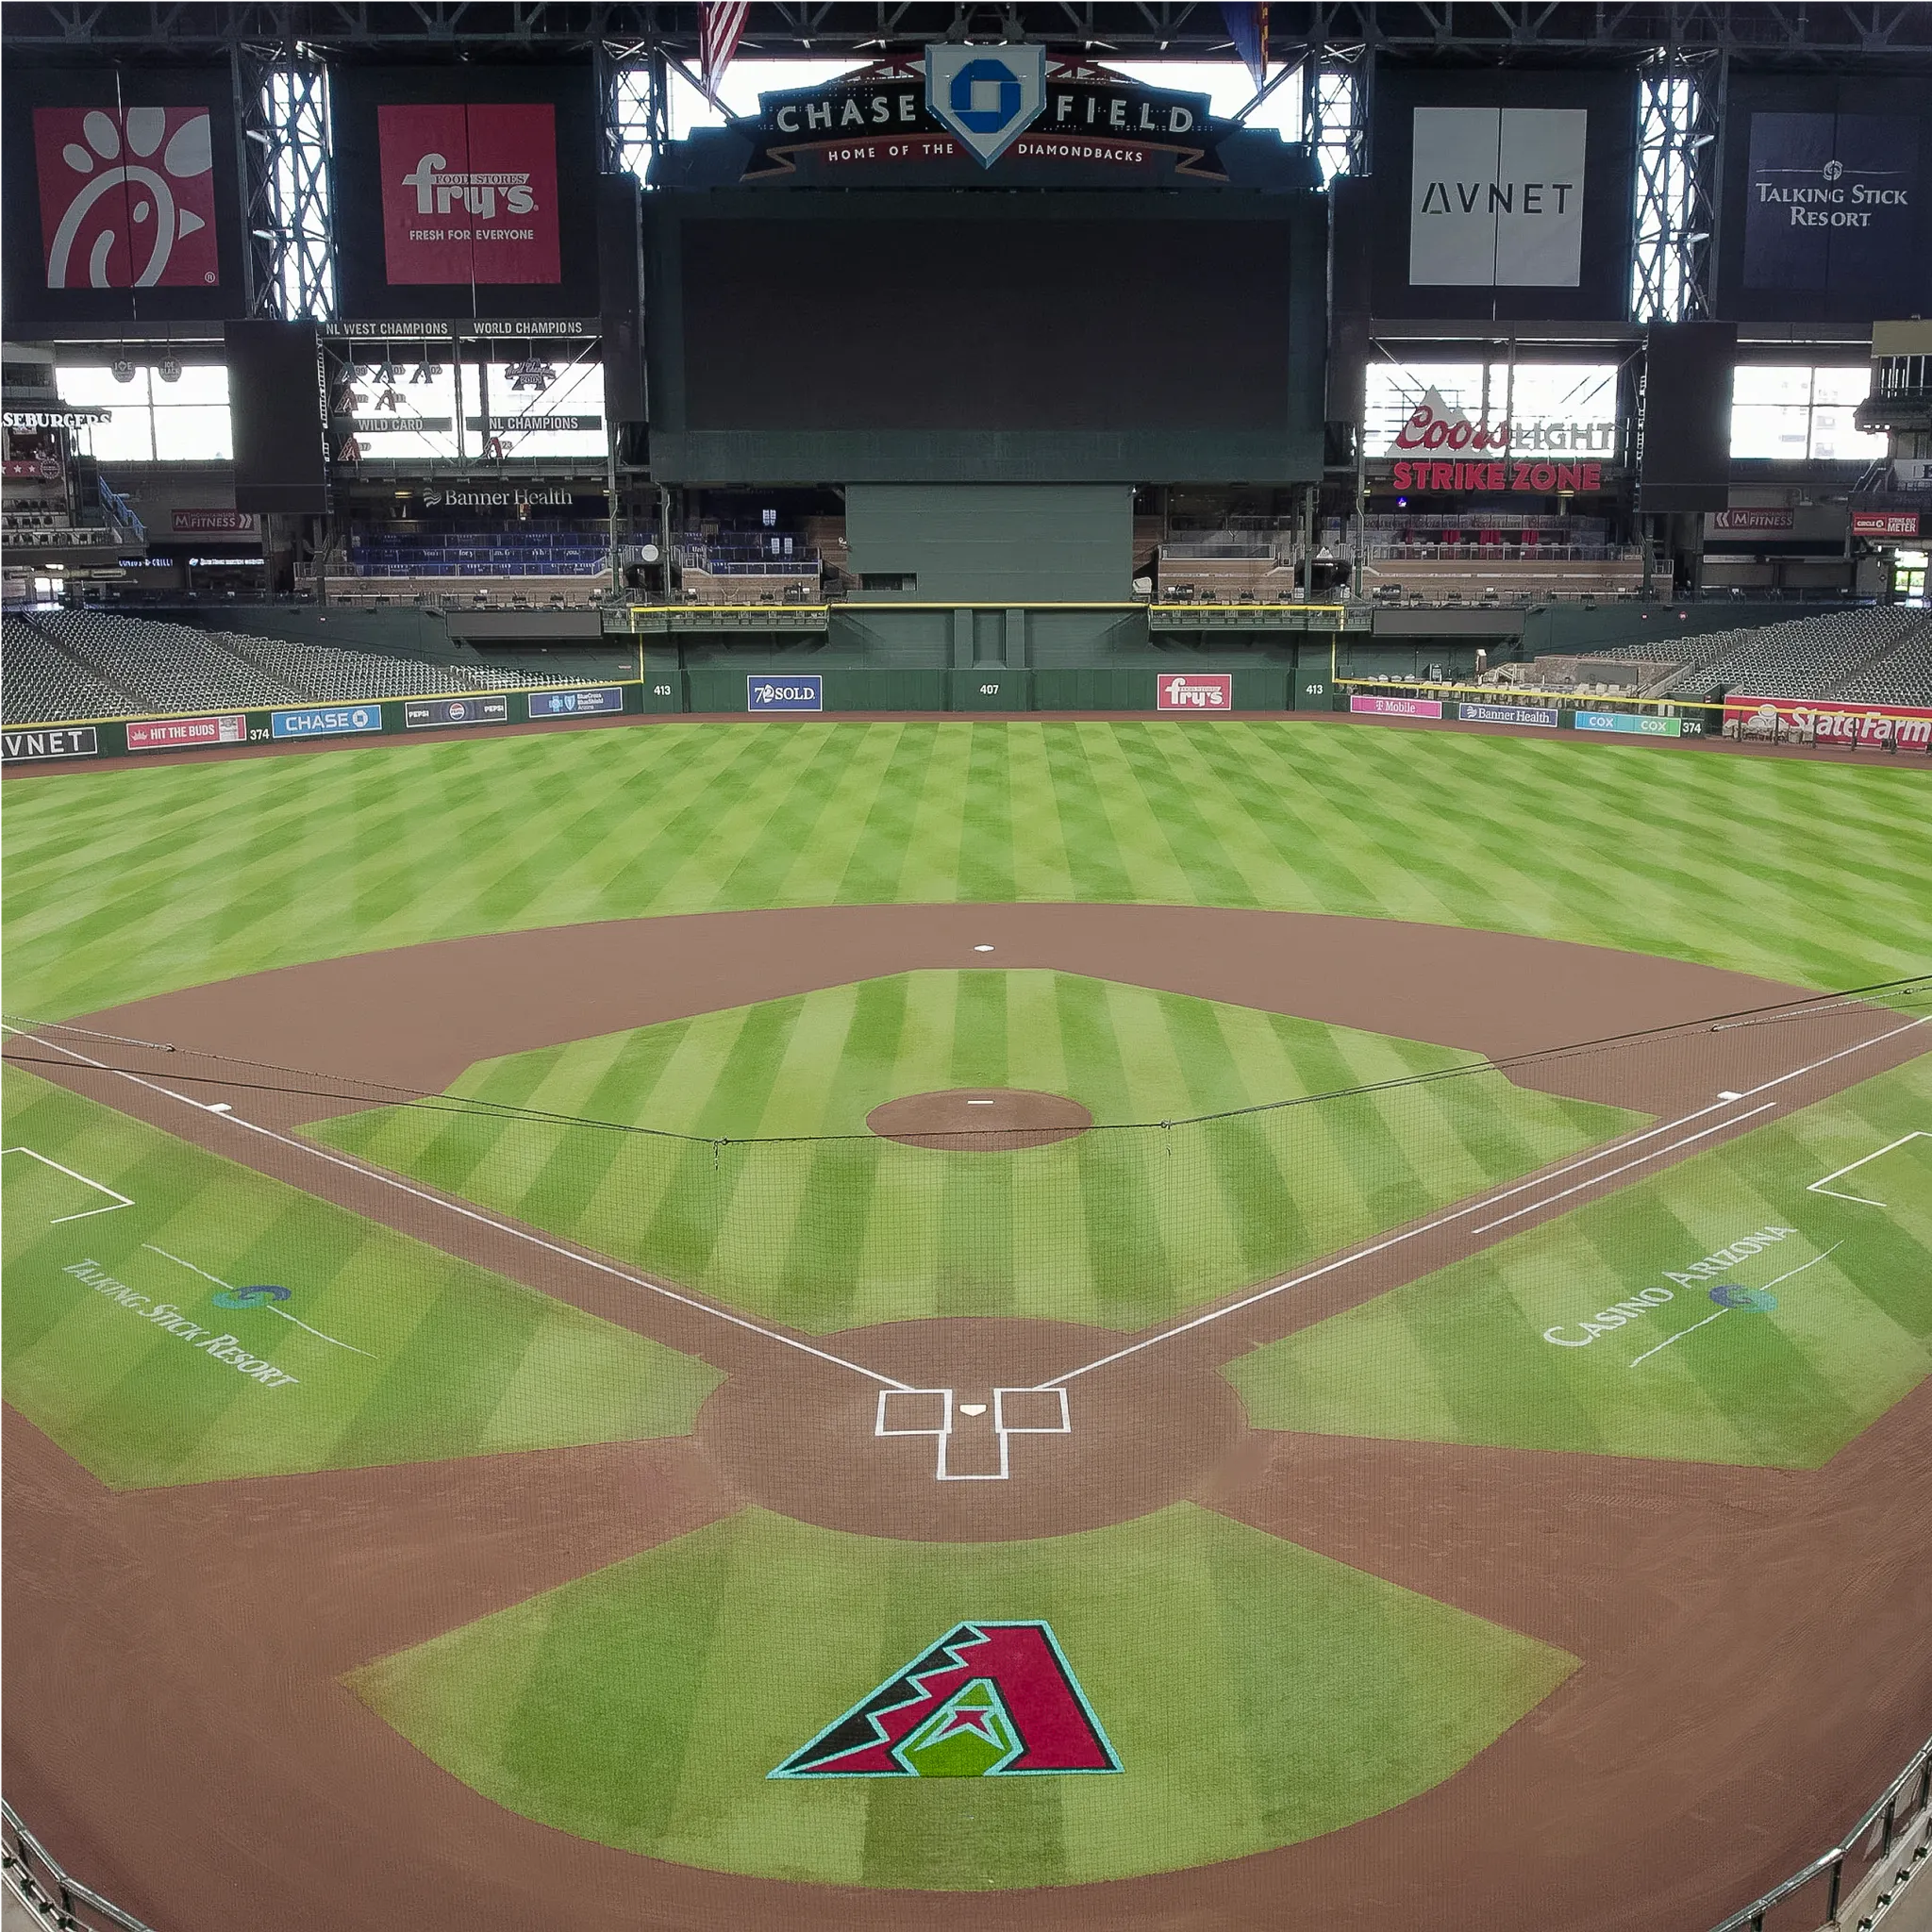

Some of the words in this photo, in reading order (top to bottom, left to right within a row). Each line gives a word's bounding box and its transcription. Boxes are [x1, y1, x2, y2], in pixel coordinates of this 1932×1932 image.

[776, 94, 916, 133] CHASE
[1057, 94, 1193, 133] FIELD
[828, 148, 875, 161] HOME
[889, 145, 909, 157] OF
[922, 143, 954, 155] THE
[1018, 143, 1143, 162] DIAMONDBACKS
[476, 174, 526, 184] STORES
[402, 153, 535, 220] fry's
[1421, 181, 1574, 215] AVNET
[409, 229, 444, 241] FRESH
[448, 229, 472, 240] FOR
[475, 229, 534, 240] EVERYONE
[325, 323, 341, 335] NL
[343, 323, 376, 335] WEST
[380, 322, 448, 334] CHAMPIONS
[474, 322, 511, 334] WORLD
[515, 322, 583, 334] CHAMPIONS
[0, 411, 112, 429] SEBURGERS
[358, 419, 389, 431] WILD
[392, 419, 424, 431] CARD
[490, 418, 505, 430] NL
[508, 417, 579, 429] CHAMPIONS
[1396, 405, 1510, 450] Coors
[1515, 422, 1614, 450] LIGHT
[1393, 461, 1507, 490] STRIKE
[1511, 462, 1603, 491] ZONE
[445, 490, 510, 506] Banner
[514, 488, 574, 505] Health
[192, 517, 236, 527] FITNESS
[1750, 516, 1792, 525] FITNESS
[1887, 523, 1916, 533] METER
[654, 685, 671, 696] 413
[979, 684, 1000, 695] 407
[1165, 677, 1224, 707] fry's
[1306, 684, 1324, 695] 413
[285, 711, 349, 732] CHASE
[1478, 707, 1515, 721] Banner
[1517, 709, 1550, 724] Health
[1589, 716, 1615, 727] COX
[151, 727, 166, 741] HIT
[168, 726, 188, 739] THE
[189, 724, 215, 737] BUDS
[1641, 720, 1667, 732] COX
[1682, 722, 1702, 734] 374
[250, 728, 270, 741] 374
[0, 730, 83, 758] VNET
